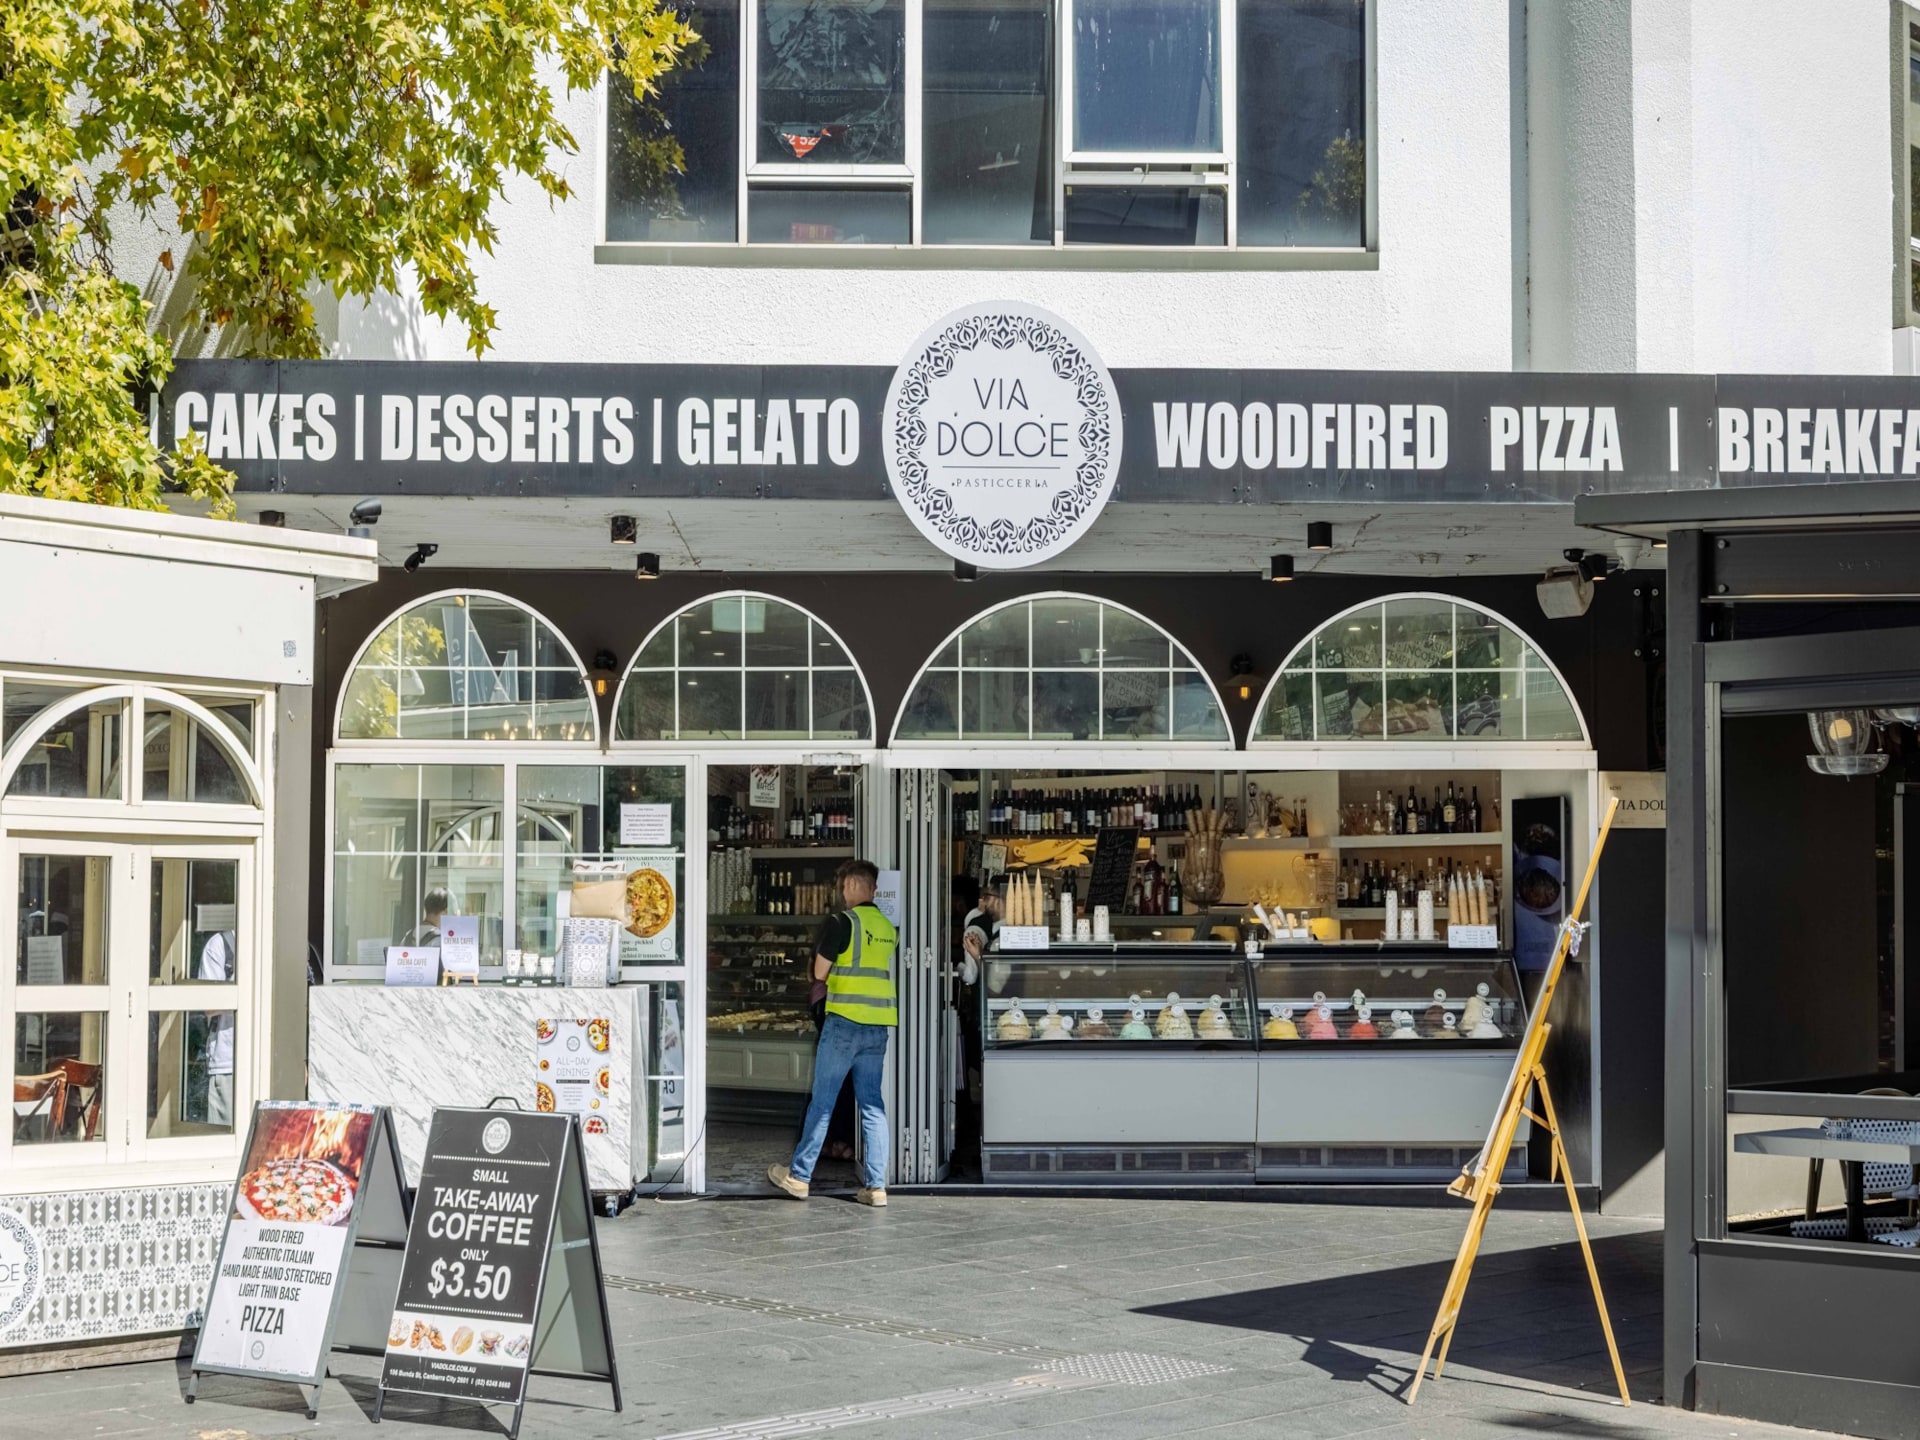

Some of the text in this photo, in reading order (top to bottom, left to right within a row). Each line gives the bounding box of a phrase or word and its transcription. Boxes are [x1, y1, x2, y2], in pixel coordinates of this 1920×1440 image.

[973, 378, 1029, 410] VIA
[175, 391, 337, 462] CAKES
[380, 395, 635, 465] DESSERTS
[677, 397, 860, 466] GELATO
[1153, 401, 1448, 471] WOODFIRED
[1490, 406, 1623, 472] PIZZA
[937, 421, 1068, 458] DOLCE
[956, 478, 1048, 489] PASTICCERIA
[556, 1057, 591, 1066] ALL-DAY
[556, 1068, 590, 1077] DINING
[472, 1169, 509, 1183] SMALL
[433, 1187, 539, 1214] TAKE-AWAY
[258, 1228, 304, 1245] WOOD FIRED
[427, 1210, 533, 1246] COFFEE
[242, 1246, 314, 1265] AUTHENTIC ITALIAN
[461, 1248, 489, 1261] ONLY
[222, 1264, 332, 1286] HAND MADE HAND STRETCHED
[427, 1257, 511, 1301] $3.50
[238, 1283, 301, 1302] LIGHT THIN BASE
[240, 1305, 285, 1335] PIZZA
[431, 1362, 477, 1374] VIADOLCE.COM.AU
[422, 1372, 446, 1382] Canberra
[446, 1374, 457, 1384] City
